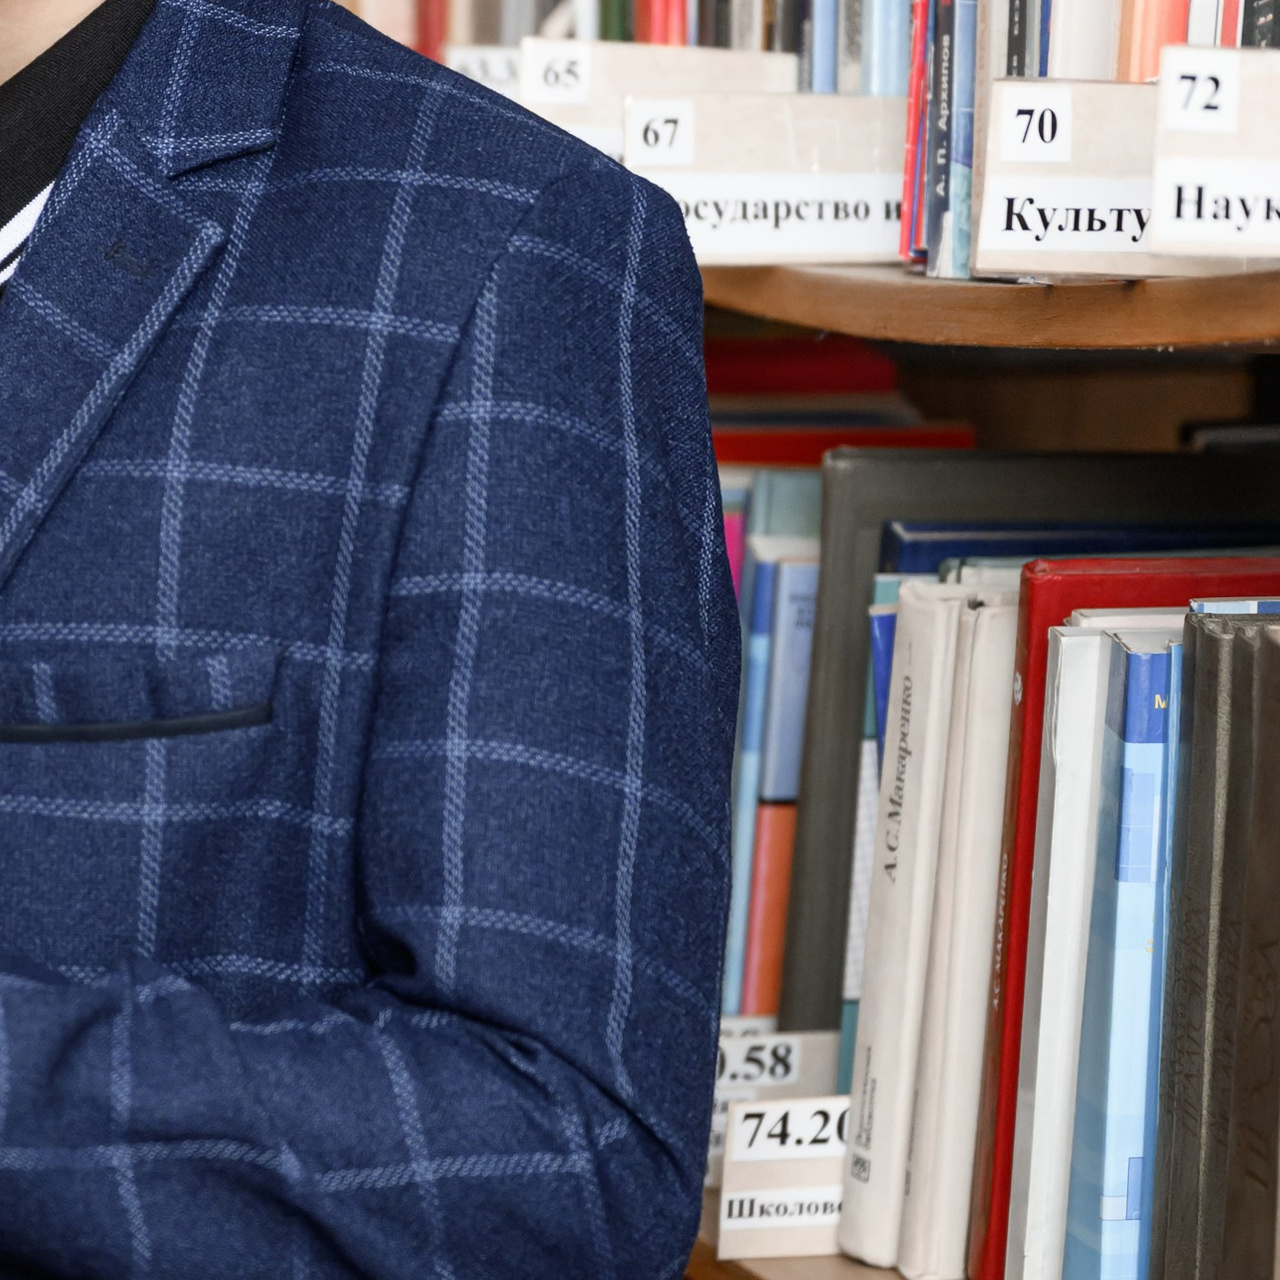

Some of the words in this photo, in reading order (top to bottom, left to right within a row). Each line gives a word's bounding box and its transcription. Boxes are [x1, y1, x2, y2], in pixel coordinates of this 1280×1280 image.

[543, 61, 580, 87] 65
[936, 34, 951, 132] Архипов
[1179, 75, 1221, 111] 72
[643, 118, 679, 147] 67
[1016, 107, 1058, 144] 70
[935, 173, 946, 196] А.
